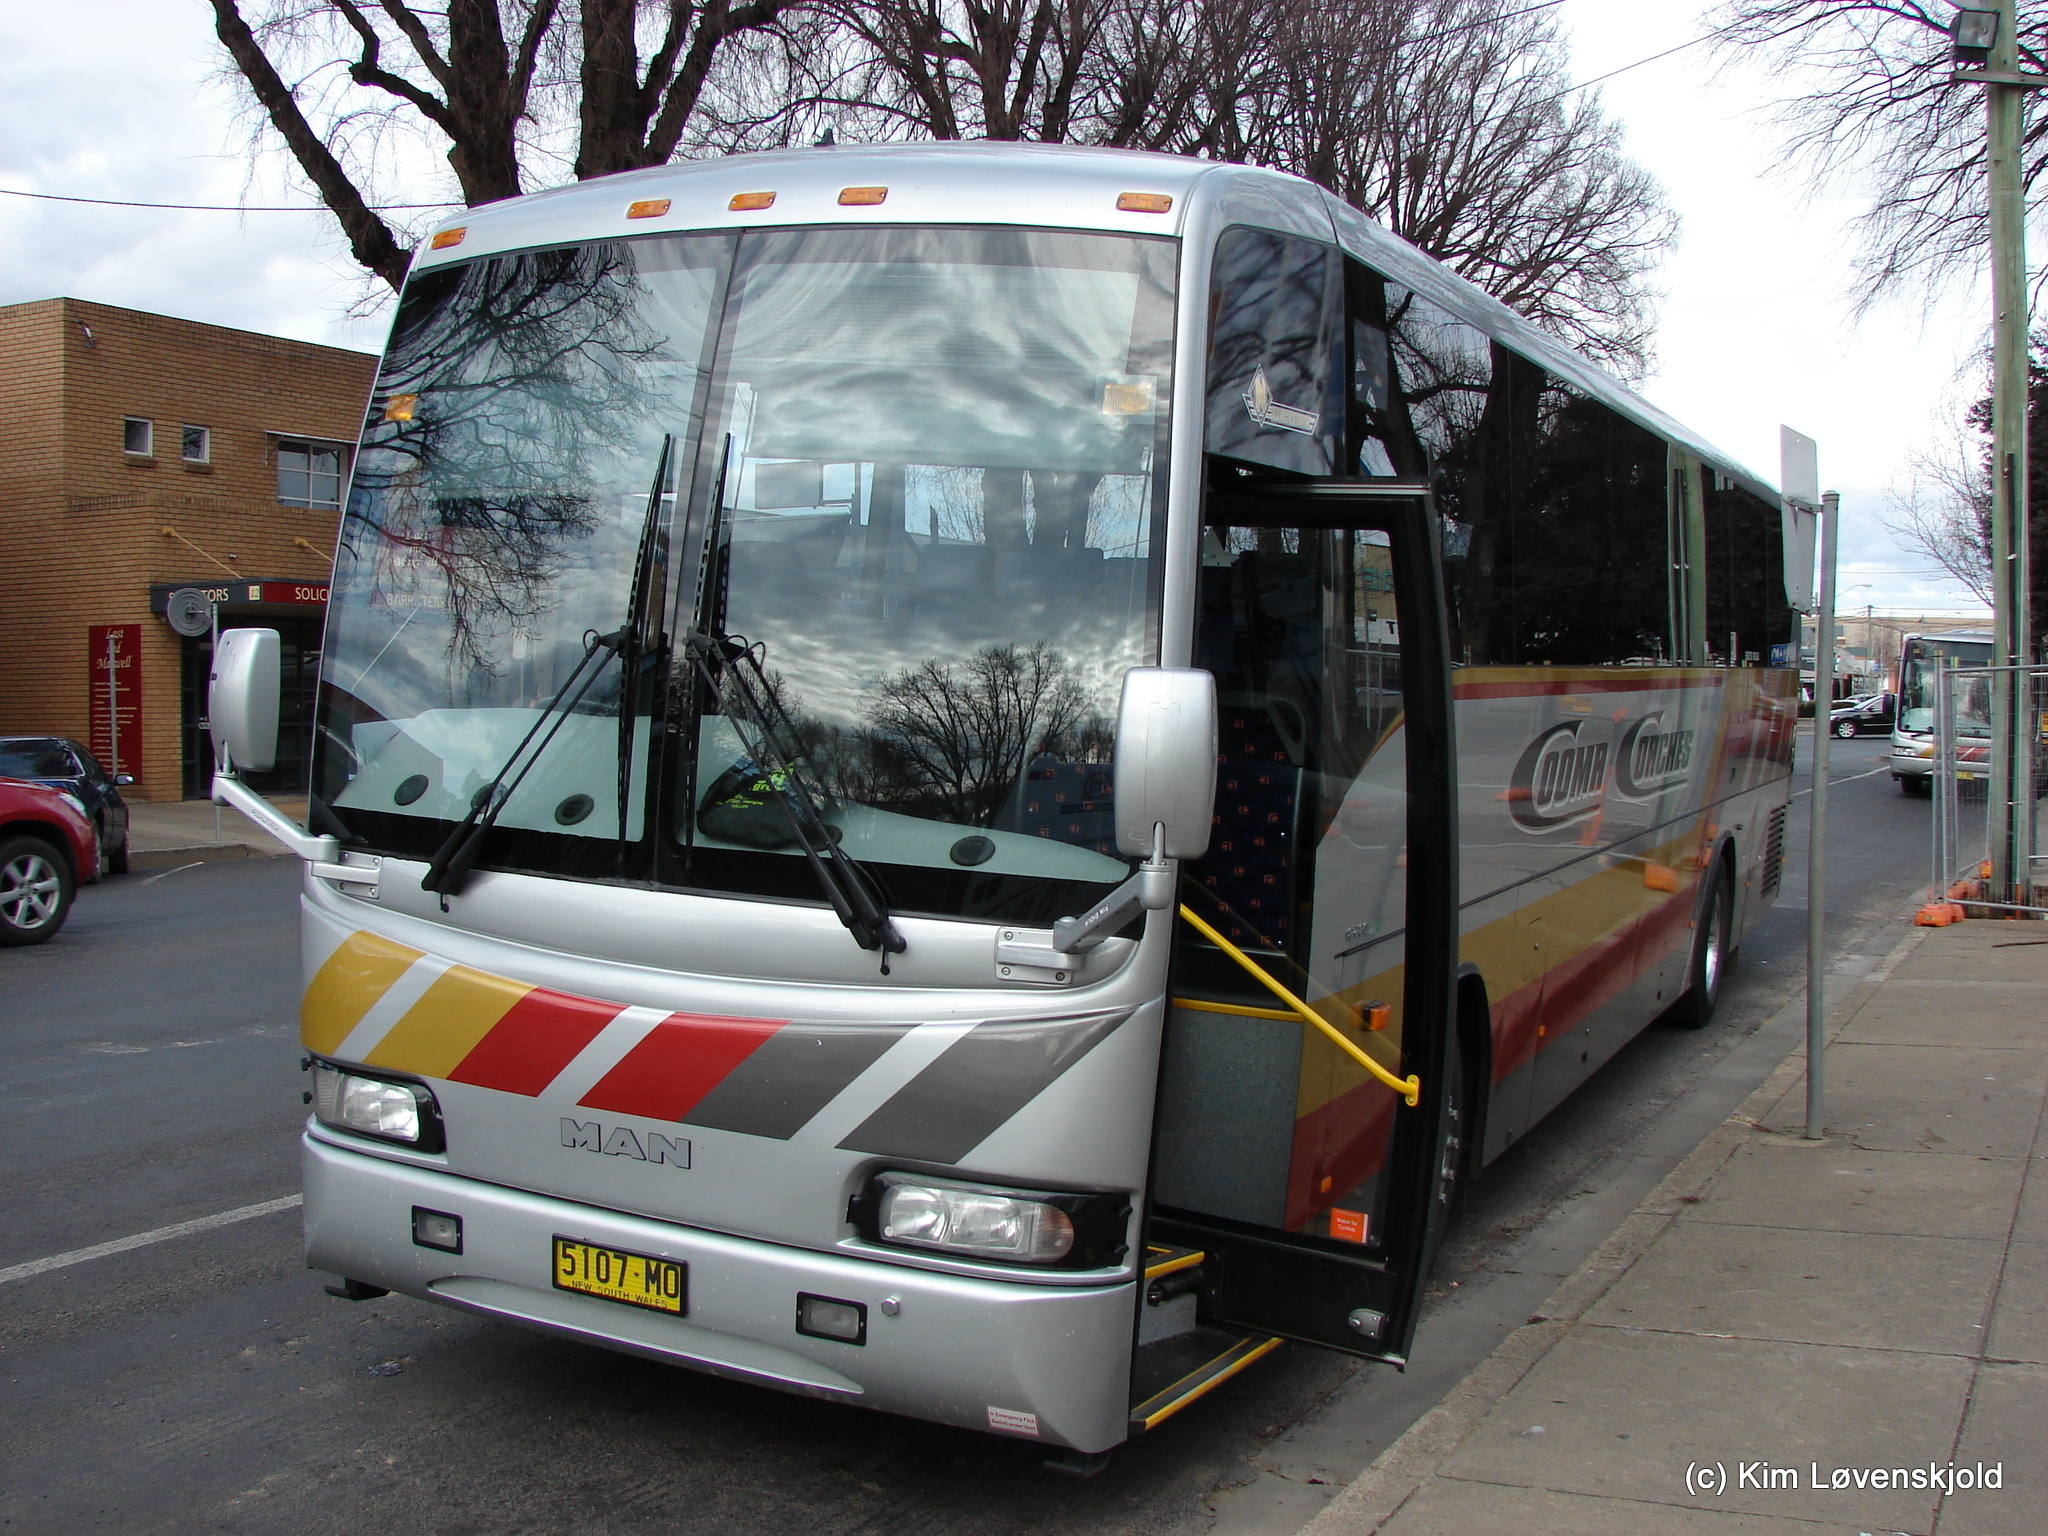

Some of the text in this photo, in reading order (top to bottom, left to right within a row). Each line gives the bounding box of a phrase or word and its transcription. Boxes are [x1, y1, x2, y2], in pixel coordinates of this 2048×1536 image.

[386, 593, 446, 608] BARRTERS
[97, 655, 133, 669] Mawell
[1509, 719, 1609, 835] COOMA
[560, 1116, 691, 1169] MAN
[562, 1242, 680, 1298] 5107 MO
[572, 1280, 668, 1309] NEW SOUTH WALES
